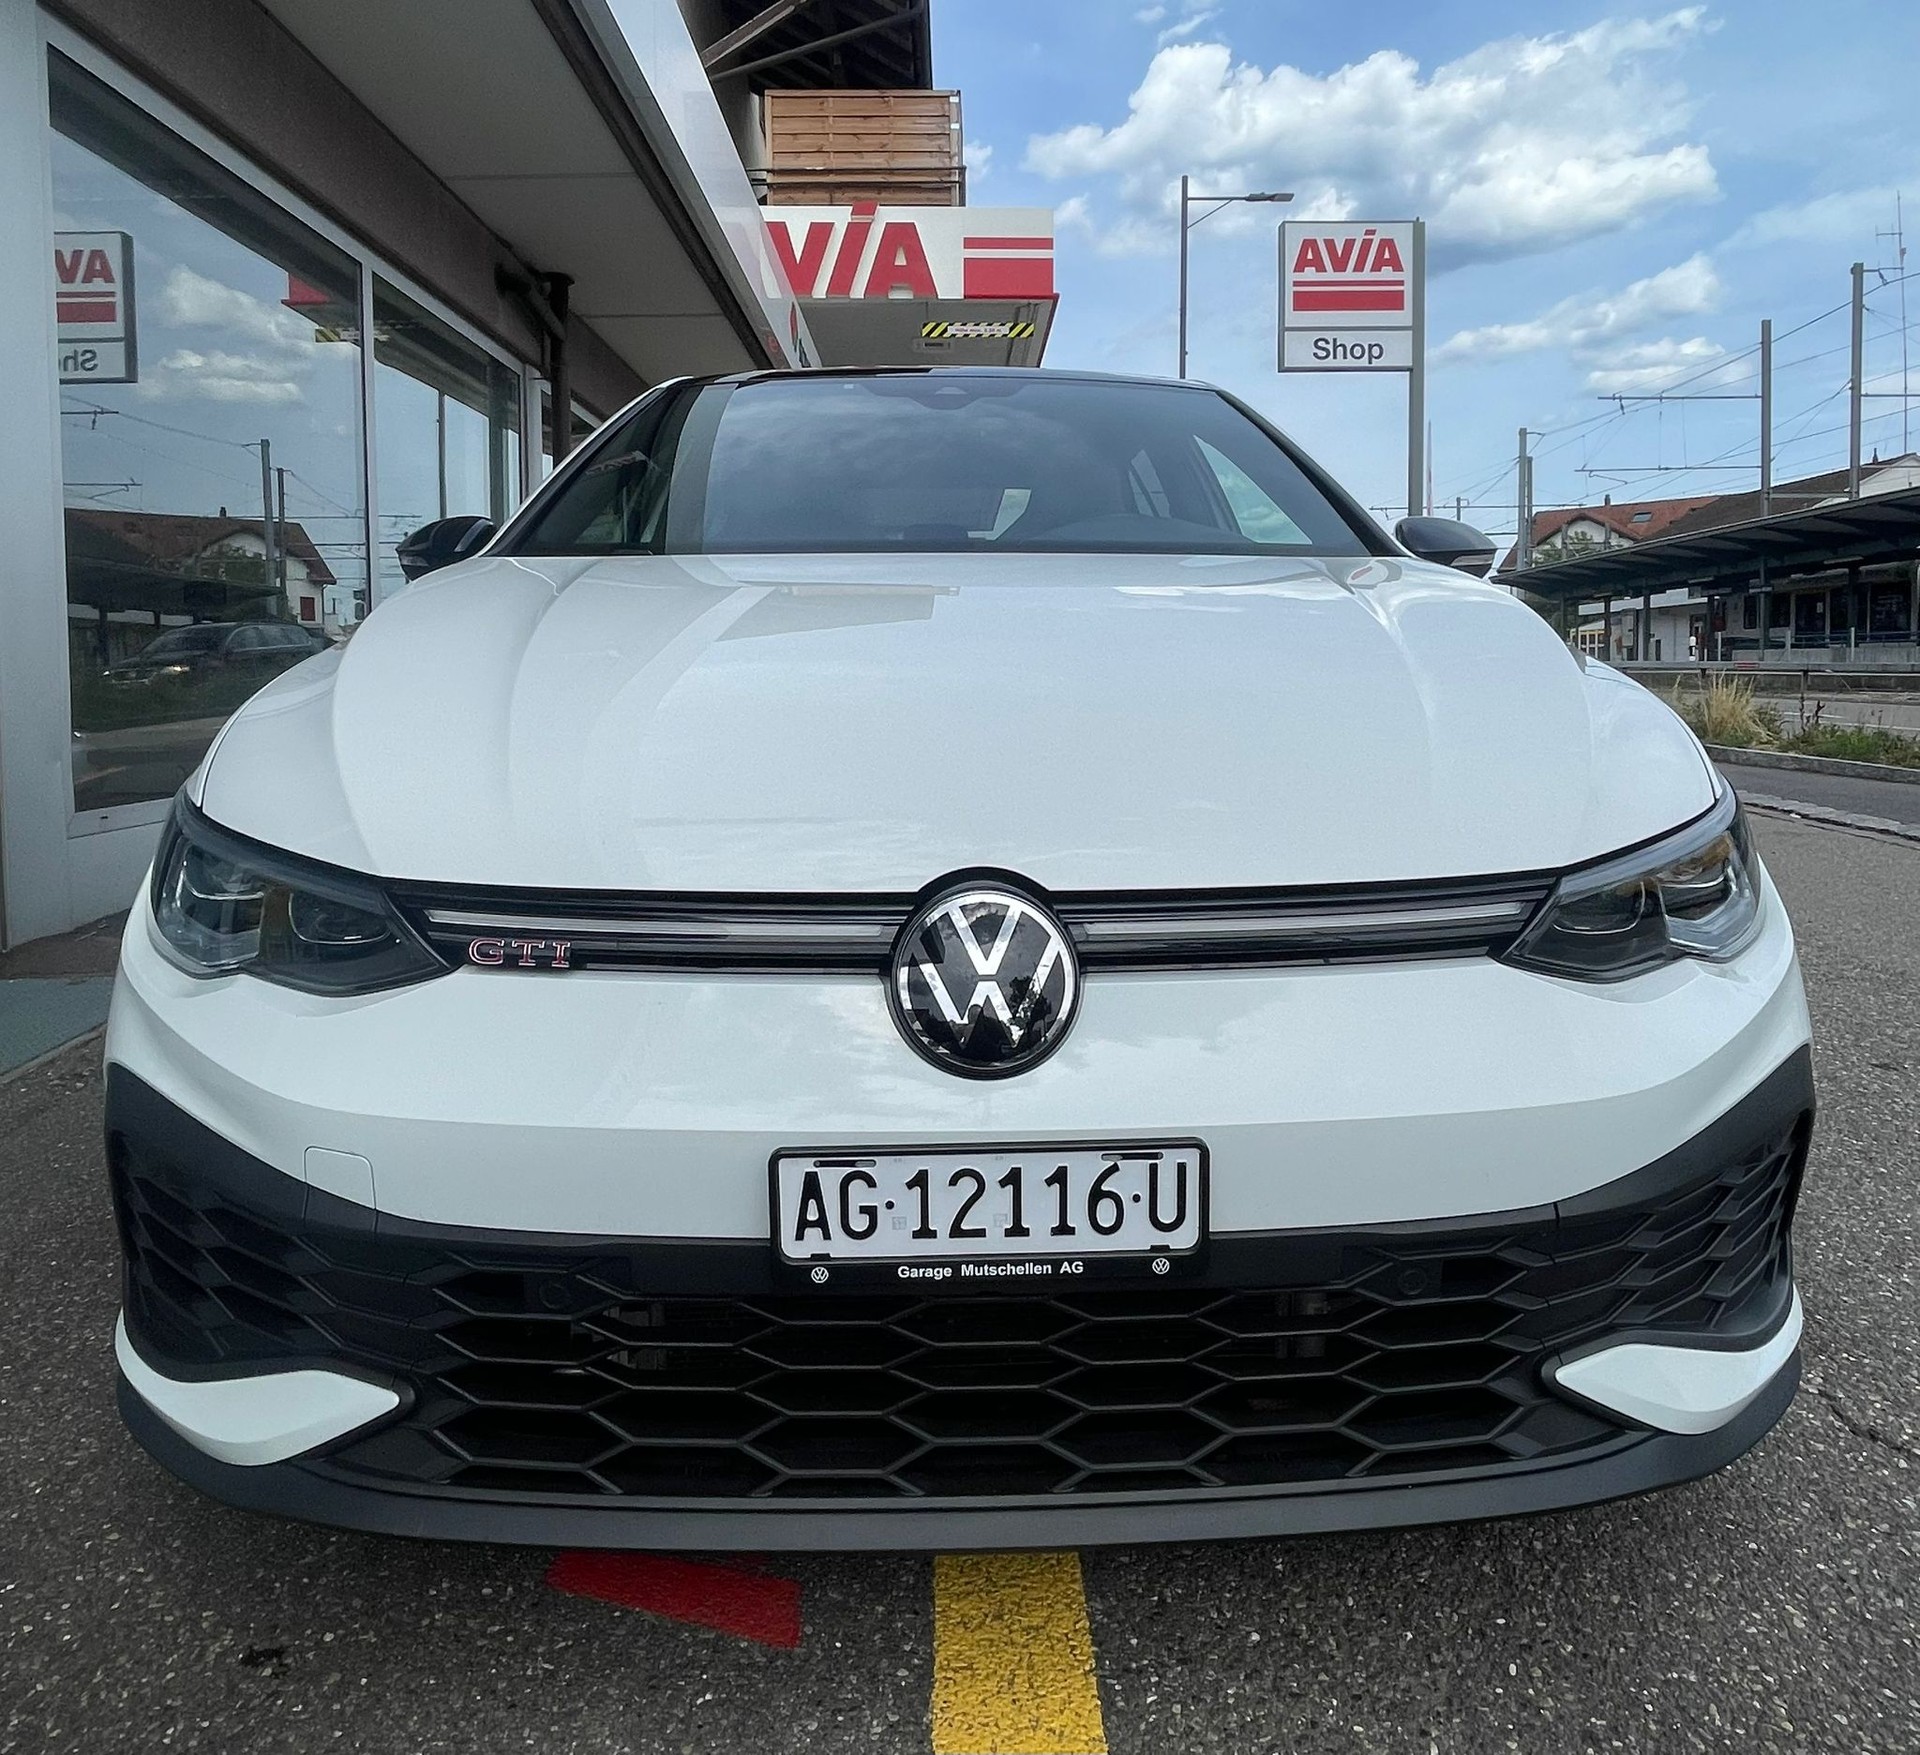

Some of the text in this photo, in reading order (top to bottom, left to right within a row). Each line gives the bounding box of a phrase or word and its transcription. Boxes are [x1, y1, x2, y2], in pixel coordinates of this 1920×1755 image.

[766, 201, 939, 298] VIA
[1292, 229, 1405, 273] AVIA
[1312, 337, 1384, 365] Shop
[468, 937, 571, 968] GTI
[897, 1261, 1084, 1280] Garage Mutschellen AG
